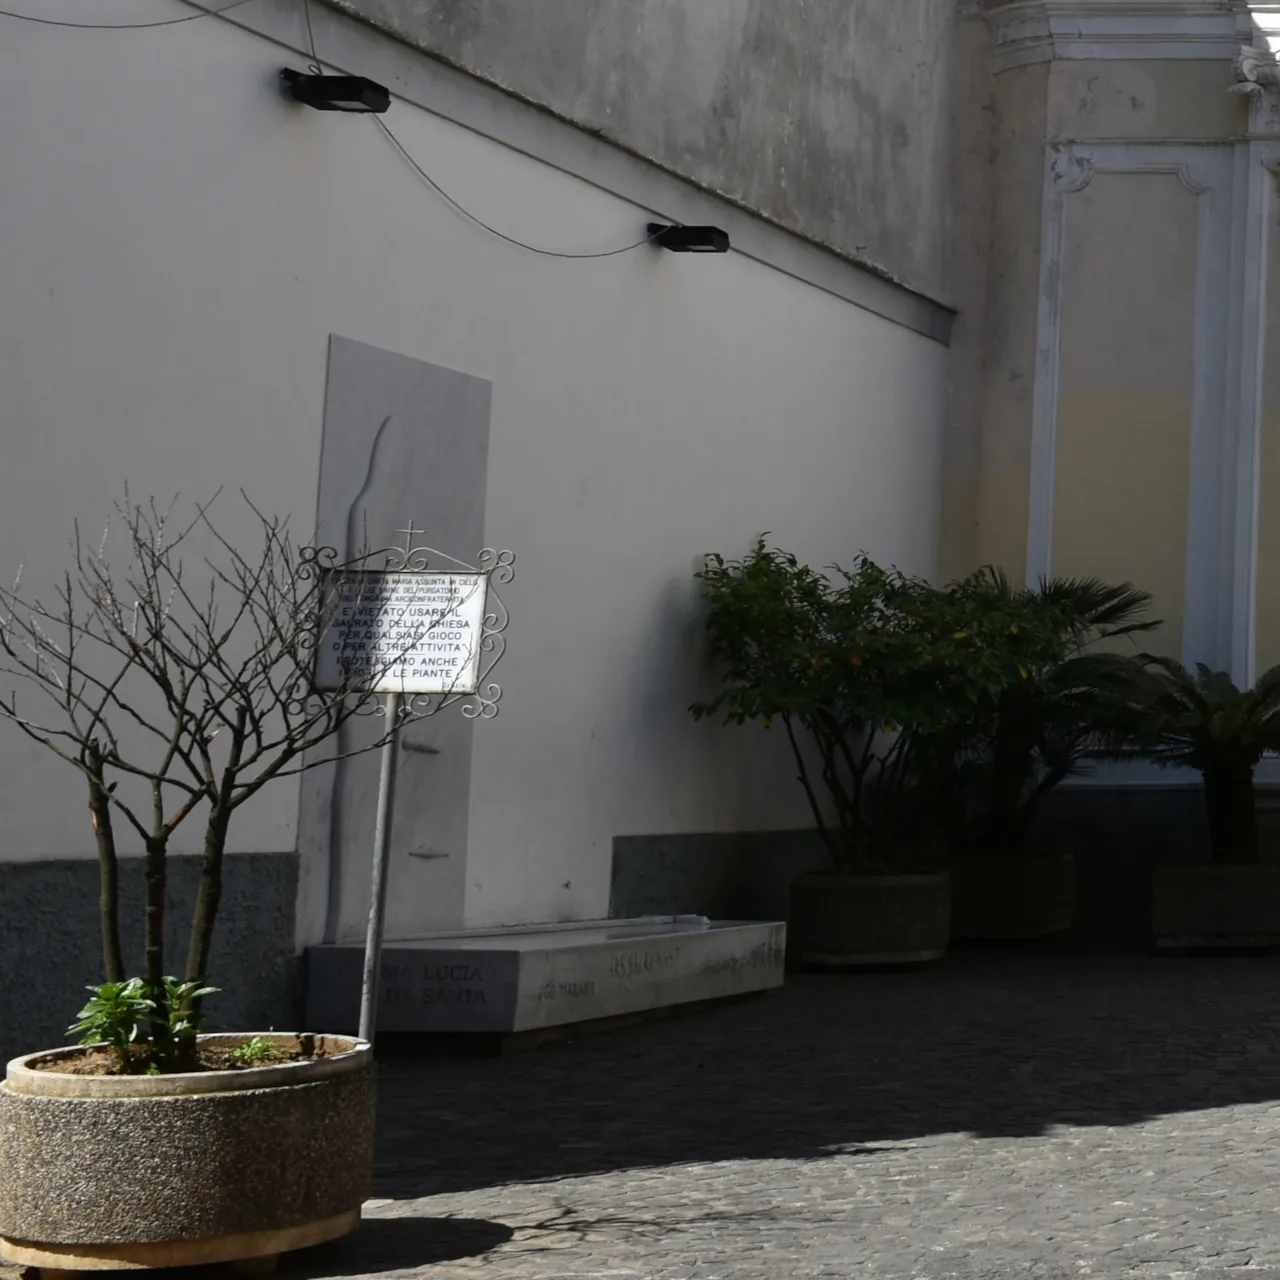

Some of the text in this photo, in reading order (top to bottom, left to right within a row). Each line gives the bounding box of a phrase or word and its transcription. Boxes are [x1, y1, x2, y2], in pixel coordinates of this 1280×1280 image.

[358, 607, 404, 616] VIETATO
[409, 608, 447, 617] USARE
[451, 609, 461, 617] IL
[389, 619, 425, 628] DELLA
[430, 620, 470, 629] CHIESA
[428, 631, 462, 640] GIOCO
[370, 642, 407, 652] ALTRE
[420, 657, 458, 666] ANCHE
[412, 668, 452, 677] PIANTE
[422, 963, 484, 982] LUCIA
